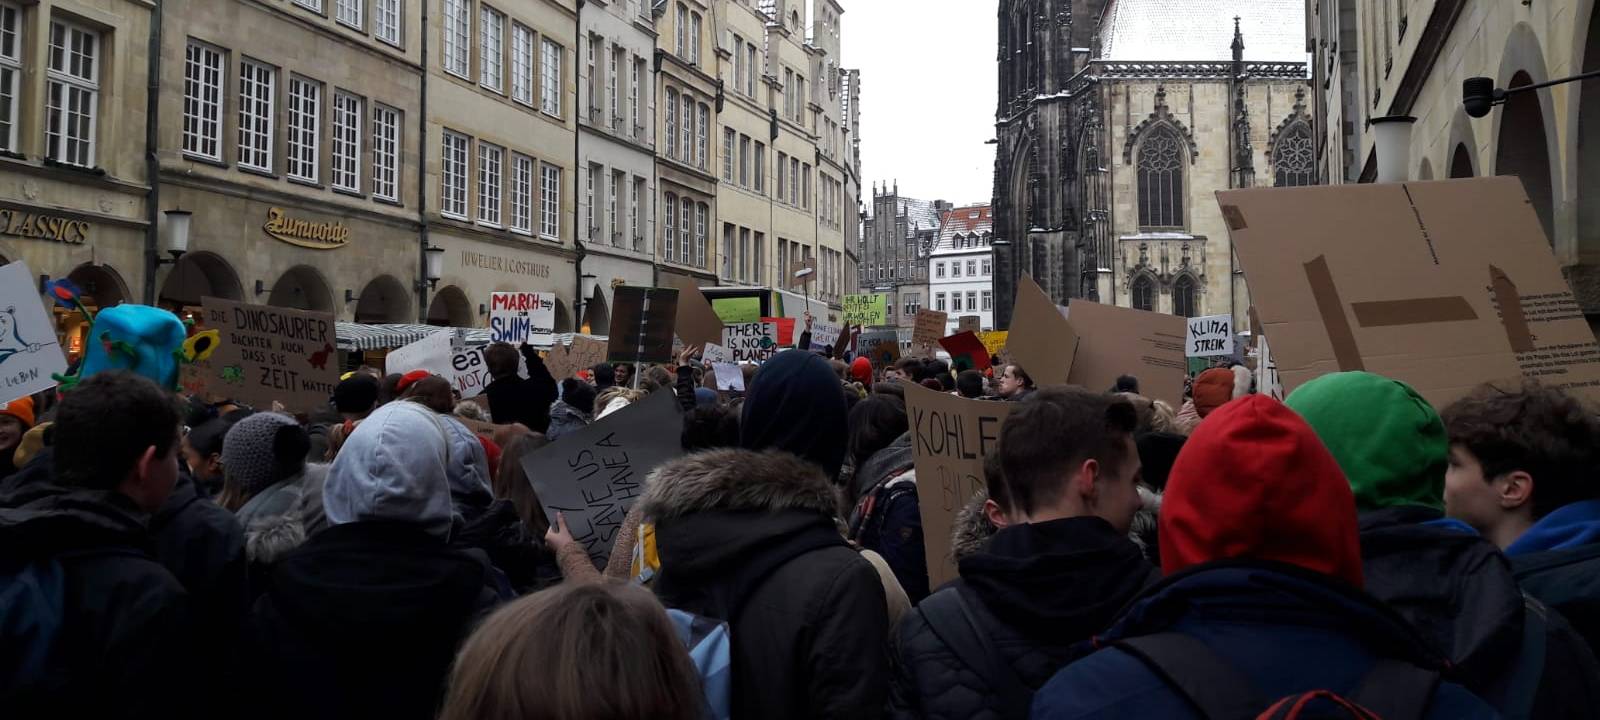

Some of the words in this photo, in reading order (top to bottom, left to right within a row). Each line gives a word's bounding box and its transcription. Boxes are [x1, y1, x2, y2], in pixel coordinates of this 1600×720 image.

[0, 208, 89, 243] CLASSICS
[264, 207, 349, 248] Zumnorde
[461, 251, 502, 271] JUWELIER
[492, 293, 539, 311] MARCH
[211, 310, 227, 324] DIE
[234, 307, 327, 342] DINOSAURIER
[491, 317, 529, 343] SWIM
[727, 322, 771, 337] THERE
[1189, 319, 1229, 339] KLIMA
[231, 333, 272, 350] DACHTEN
[727, 338, 737, 349] IS
[742, 338, 760, 349] NO
[1193, 338, 1226, 353] STREIK
[242, 349, 265, 363] DASS
[271, 353, 287, 366] SIE
[733, 348, 772, 361] PLANET
[259, 366, 299, 392] ZEIT
[458, 370, 481, 392] NOT
[595, 431, 622, 448] A
[568, 449, 600, 481] US
[602, 451, 640, 501] HAVE
[582, 484, 621, 544] SAVE
